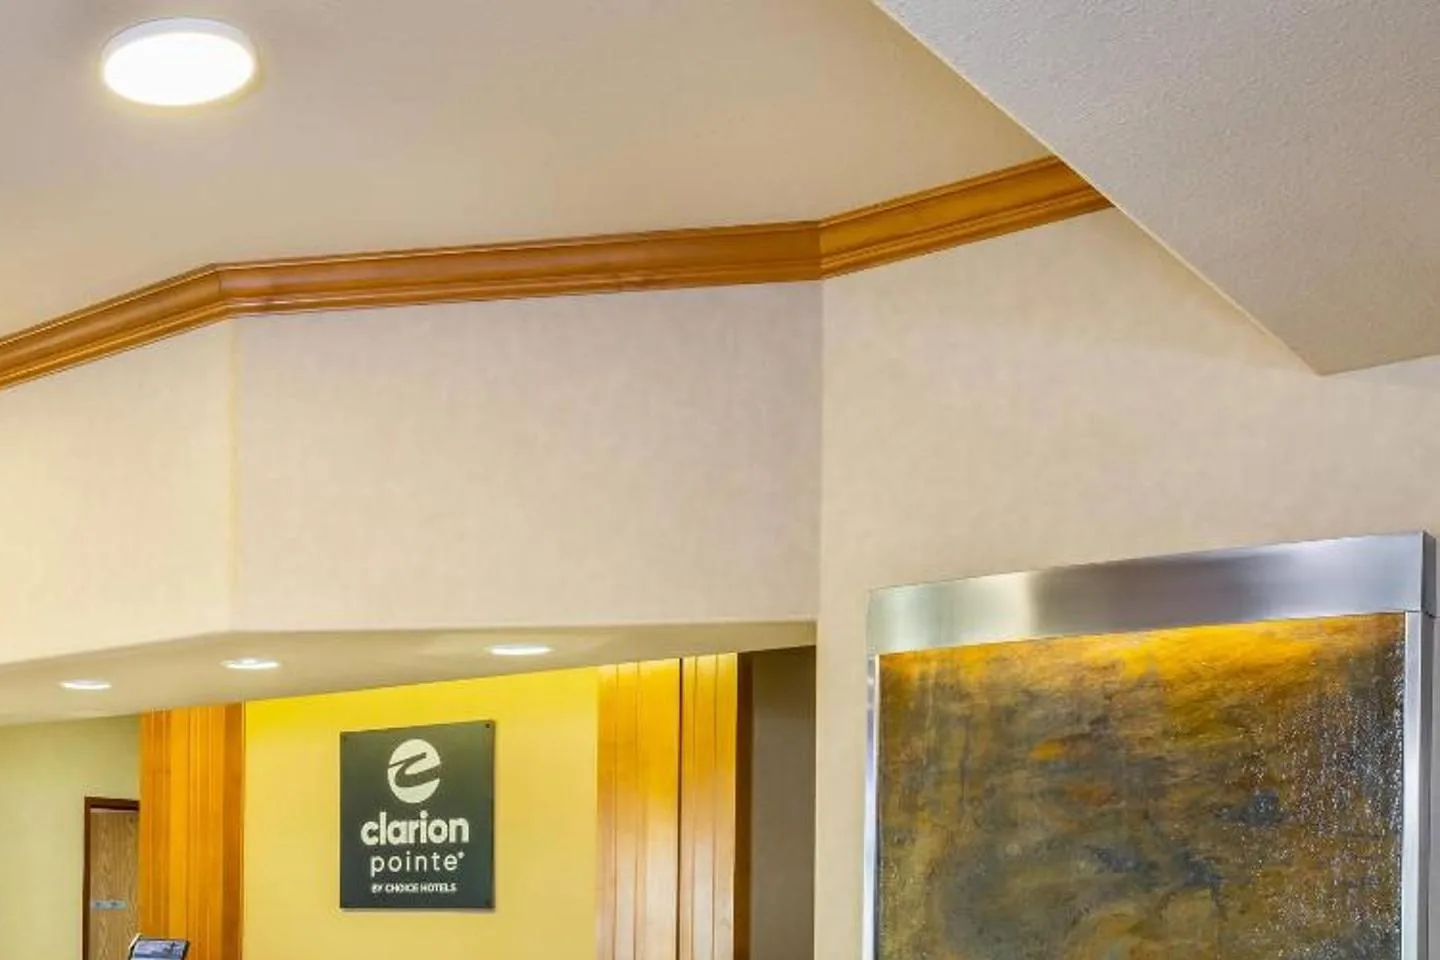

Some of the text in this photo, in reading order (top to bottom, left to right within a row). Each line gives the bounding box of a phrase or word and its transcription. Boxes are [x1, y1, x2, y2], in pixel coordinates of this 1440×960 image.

[361, 810, 470, 845] clarion
[370, 851, 459, 877] pointe
[420, 882, 456, 893] HOTELS
